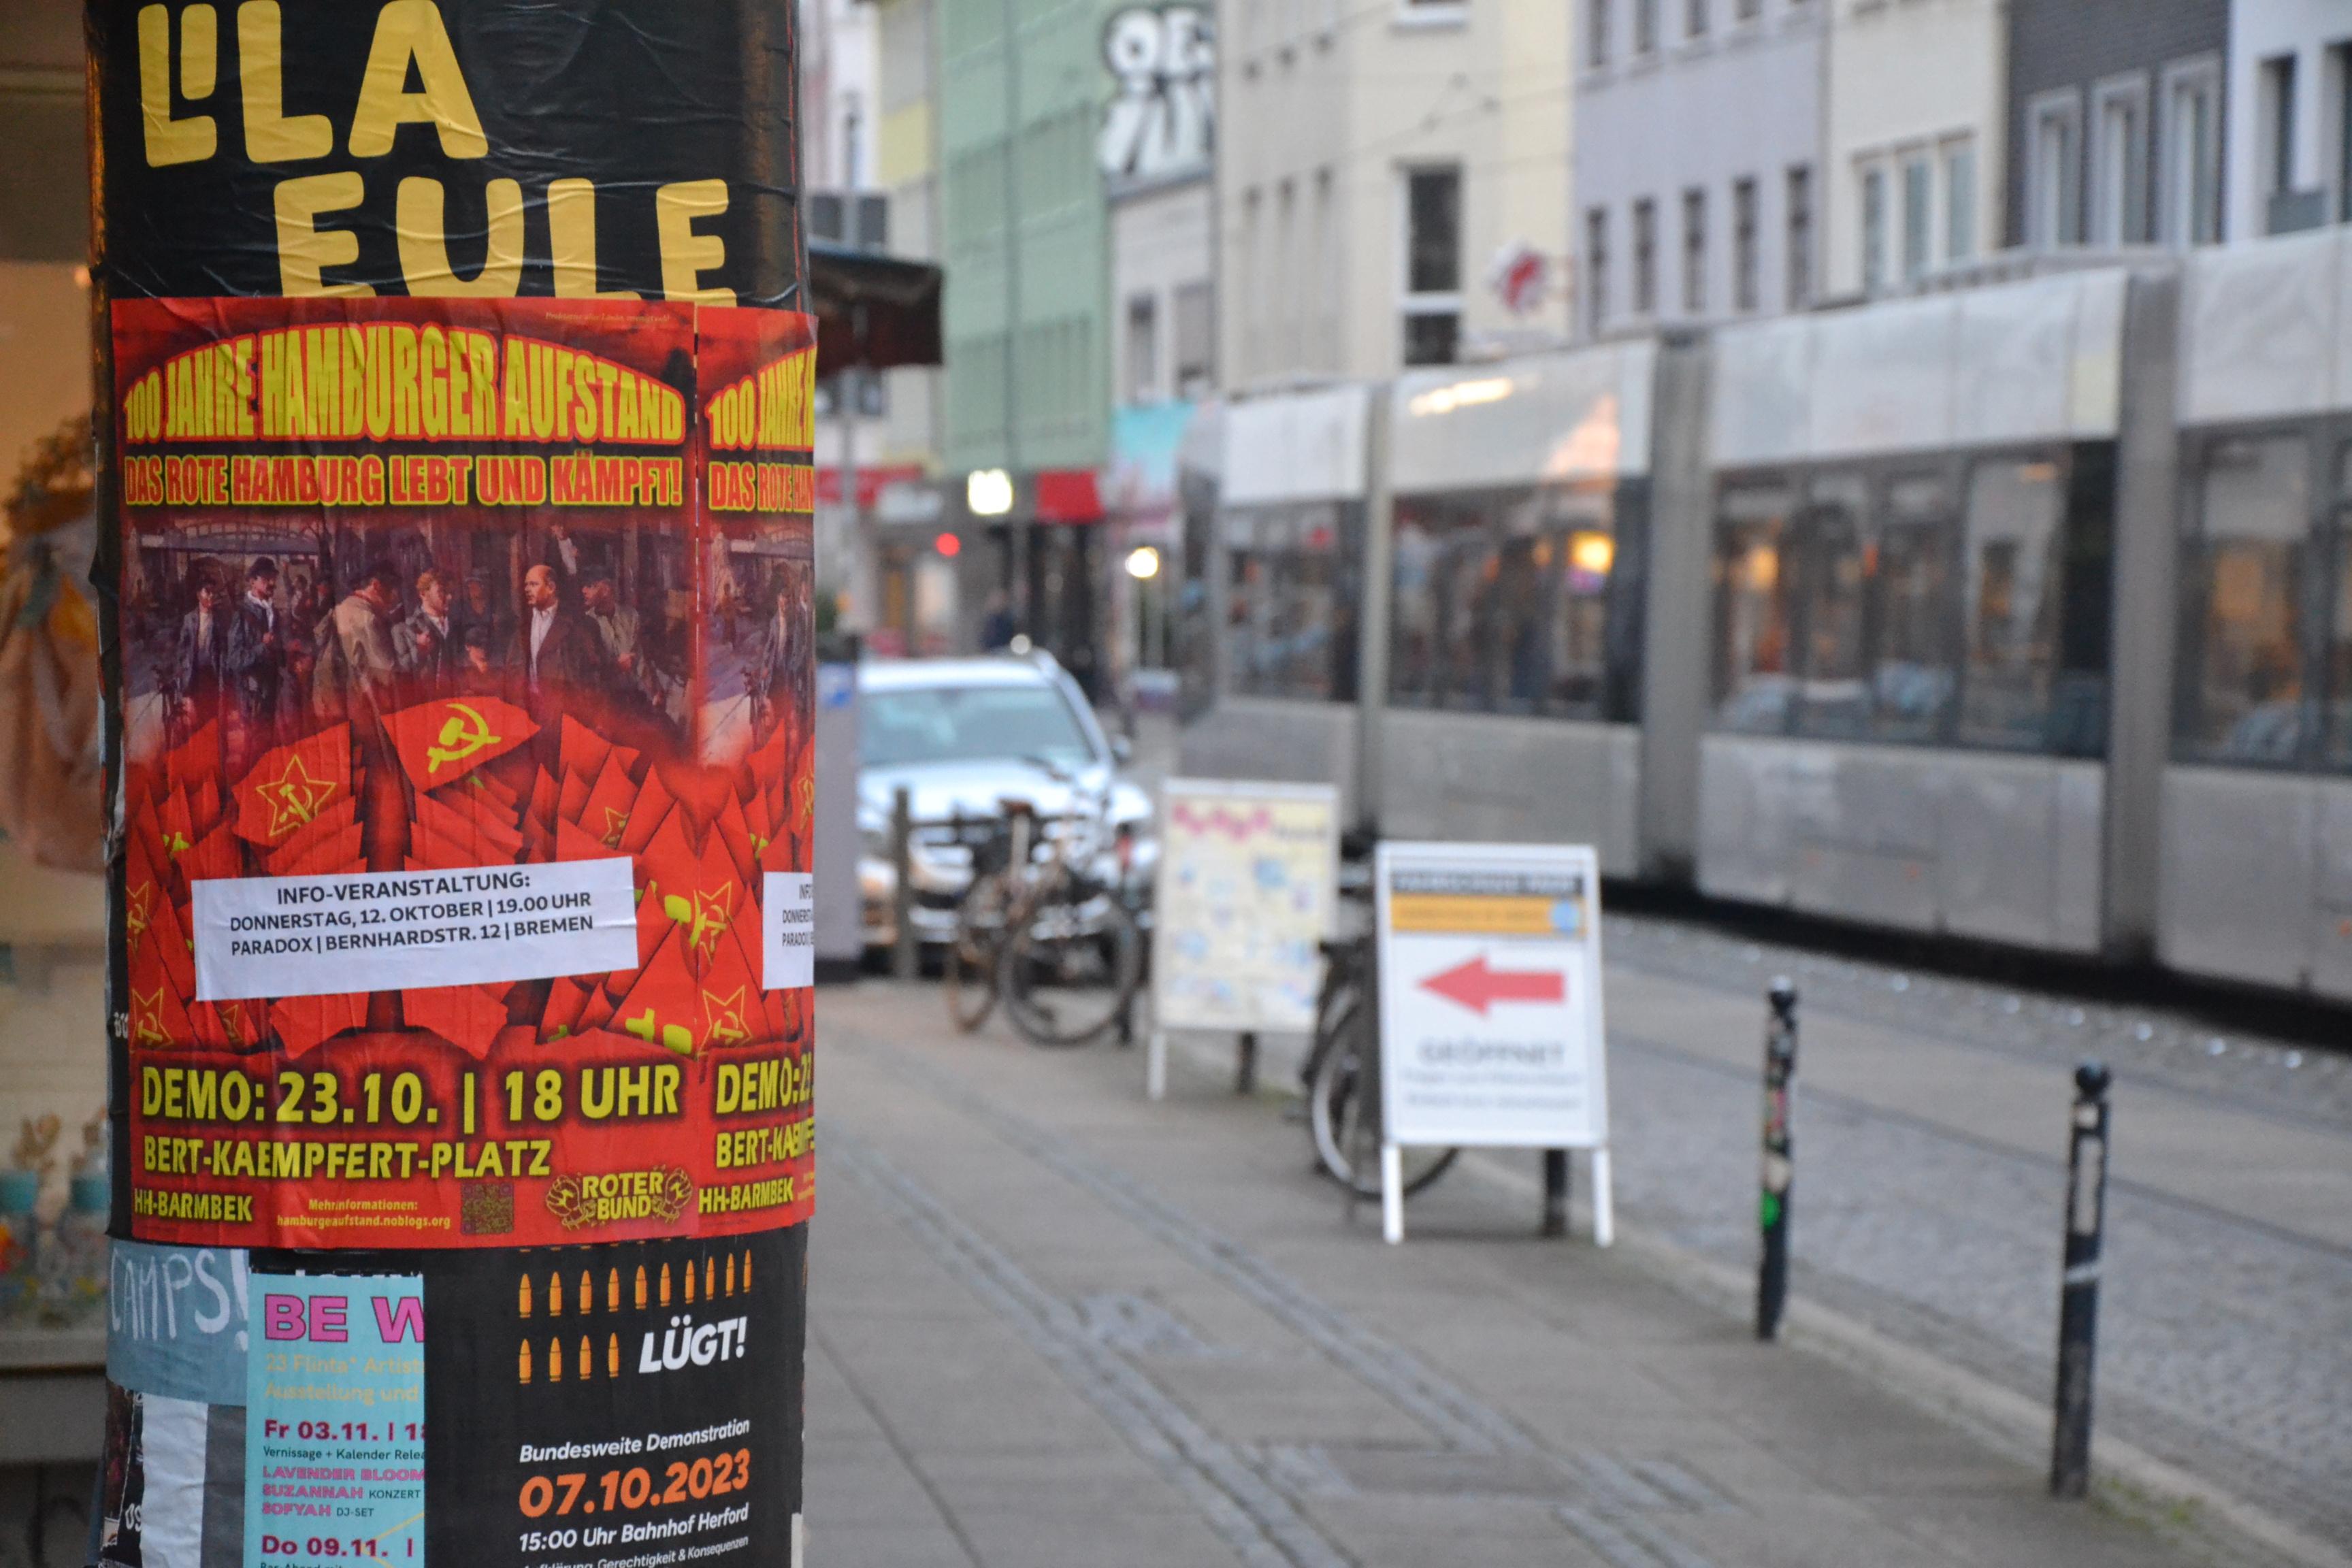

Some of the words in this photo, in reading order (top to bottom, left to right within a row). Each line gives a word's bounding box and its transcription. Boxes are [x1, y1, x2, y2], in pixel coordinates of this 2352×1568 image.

[274, 172, 738, 305] EULE
[124, 370, 161, 440] 100
[165, 337, 255, 438] JAHRE
[261, 325, 497, 438] HAMBURGER
[504, 338, 683, 442] AUFSTAND
[706, 376, 755, 448] 100
[757, 351, 806, 448] JAHRE
[125, 455, 163, 505] DAS
[165, 455, 229, 505] ROTE
[231, 455, 385, 506] HAMBURG
[389, 455, 473, 505] LEBT
[475, 455, 546, 506] UND
[550, 450, 683, 506] KÄMPFT!
[708, 461, 755, 512] DAS
[757, 463, 792, 512] ROTE
[276, 870, 531, 906] INFO-VERANSTALTUNG:
[229, 911, 357, 932] DONNERSTAG,
[359, 907, 387, 926] 12.
[389, 902, 484, 924] OKTOBER
[496, 896, 549, 915] 19.00
[551, 892, 591, 911] UHR
[231, 936, 313, 956] PARADOX
[325, 926, 476, 951] BERNHARDSTR.
[479, 924, 501, 941] 12
[513, 915, 594, 937] BREMEN
[142, 1066, 265, 1122] DEMO:
[276, 1071, 438, 1124] 23.10.
[505, 1069, 562, 1122] 18
[580, 1064, 681, 1119] UHR
[716, 1056, 800, 1114] DEMO:
[144, 1134, 551, 1179] BERT-KAEMPFERT-PLATZ
[134, 1188, 253, 1222] HH-BARMBEK
[582, 1171, 664, 1199] ROTER
[698, 1176, 794, 1213] HH-BARMBEK
[596, 1195, 651, 1220] BUND
[110, 1247, 248, 1352] CAMPS!
[264, 1294, 348, 1343] BE
[638, 1314, 748, 1373] LÜGT!
[364, 1356, 424, 1375] Artist
[265, 1382, 375, 1407] Ausstellung
[380, 1386, 419, 1402] und
[264, 1418, 290, 1439] Fr
[297, 1420, 379, 1441] 03.11.
[519, 1437, 642, 1463] Bundesweite
[646, 1419, 750, 1452] Demonstration
[262, 1465, 356, 1481] LAVENDER
[263, 1446, 323, 1461] Vernissage
[336, 1449, 391, 1460] Kalender
[262, 1483, 364, 1499] SUZANNAH
[369, 1489, 421, 1499] KONZERT
[519, 1448, 750, 1518] 07.10.2023
[261, 1501, 332, 1517] SOFYAH
[336, 1507, 374, 1518] DJ-SET
[519, 1529, 577, 1552] 15:00
[583, 1526, 617, 1548] Uhr
[621, 1517, 696, 1544] Bahnhof
[697, 1501, 749, 1531] Herford
[261, 1535, 297, 1556] Do
[307, 1537, 389, 1558] 09.11.
[598, 1550, 676, 1568] Gerechtigkeit
[687, 1535, 749, 1560] Konsequenzen
